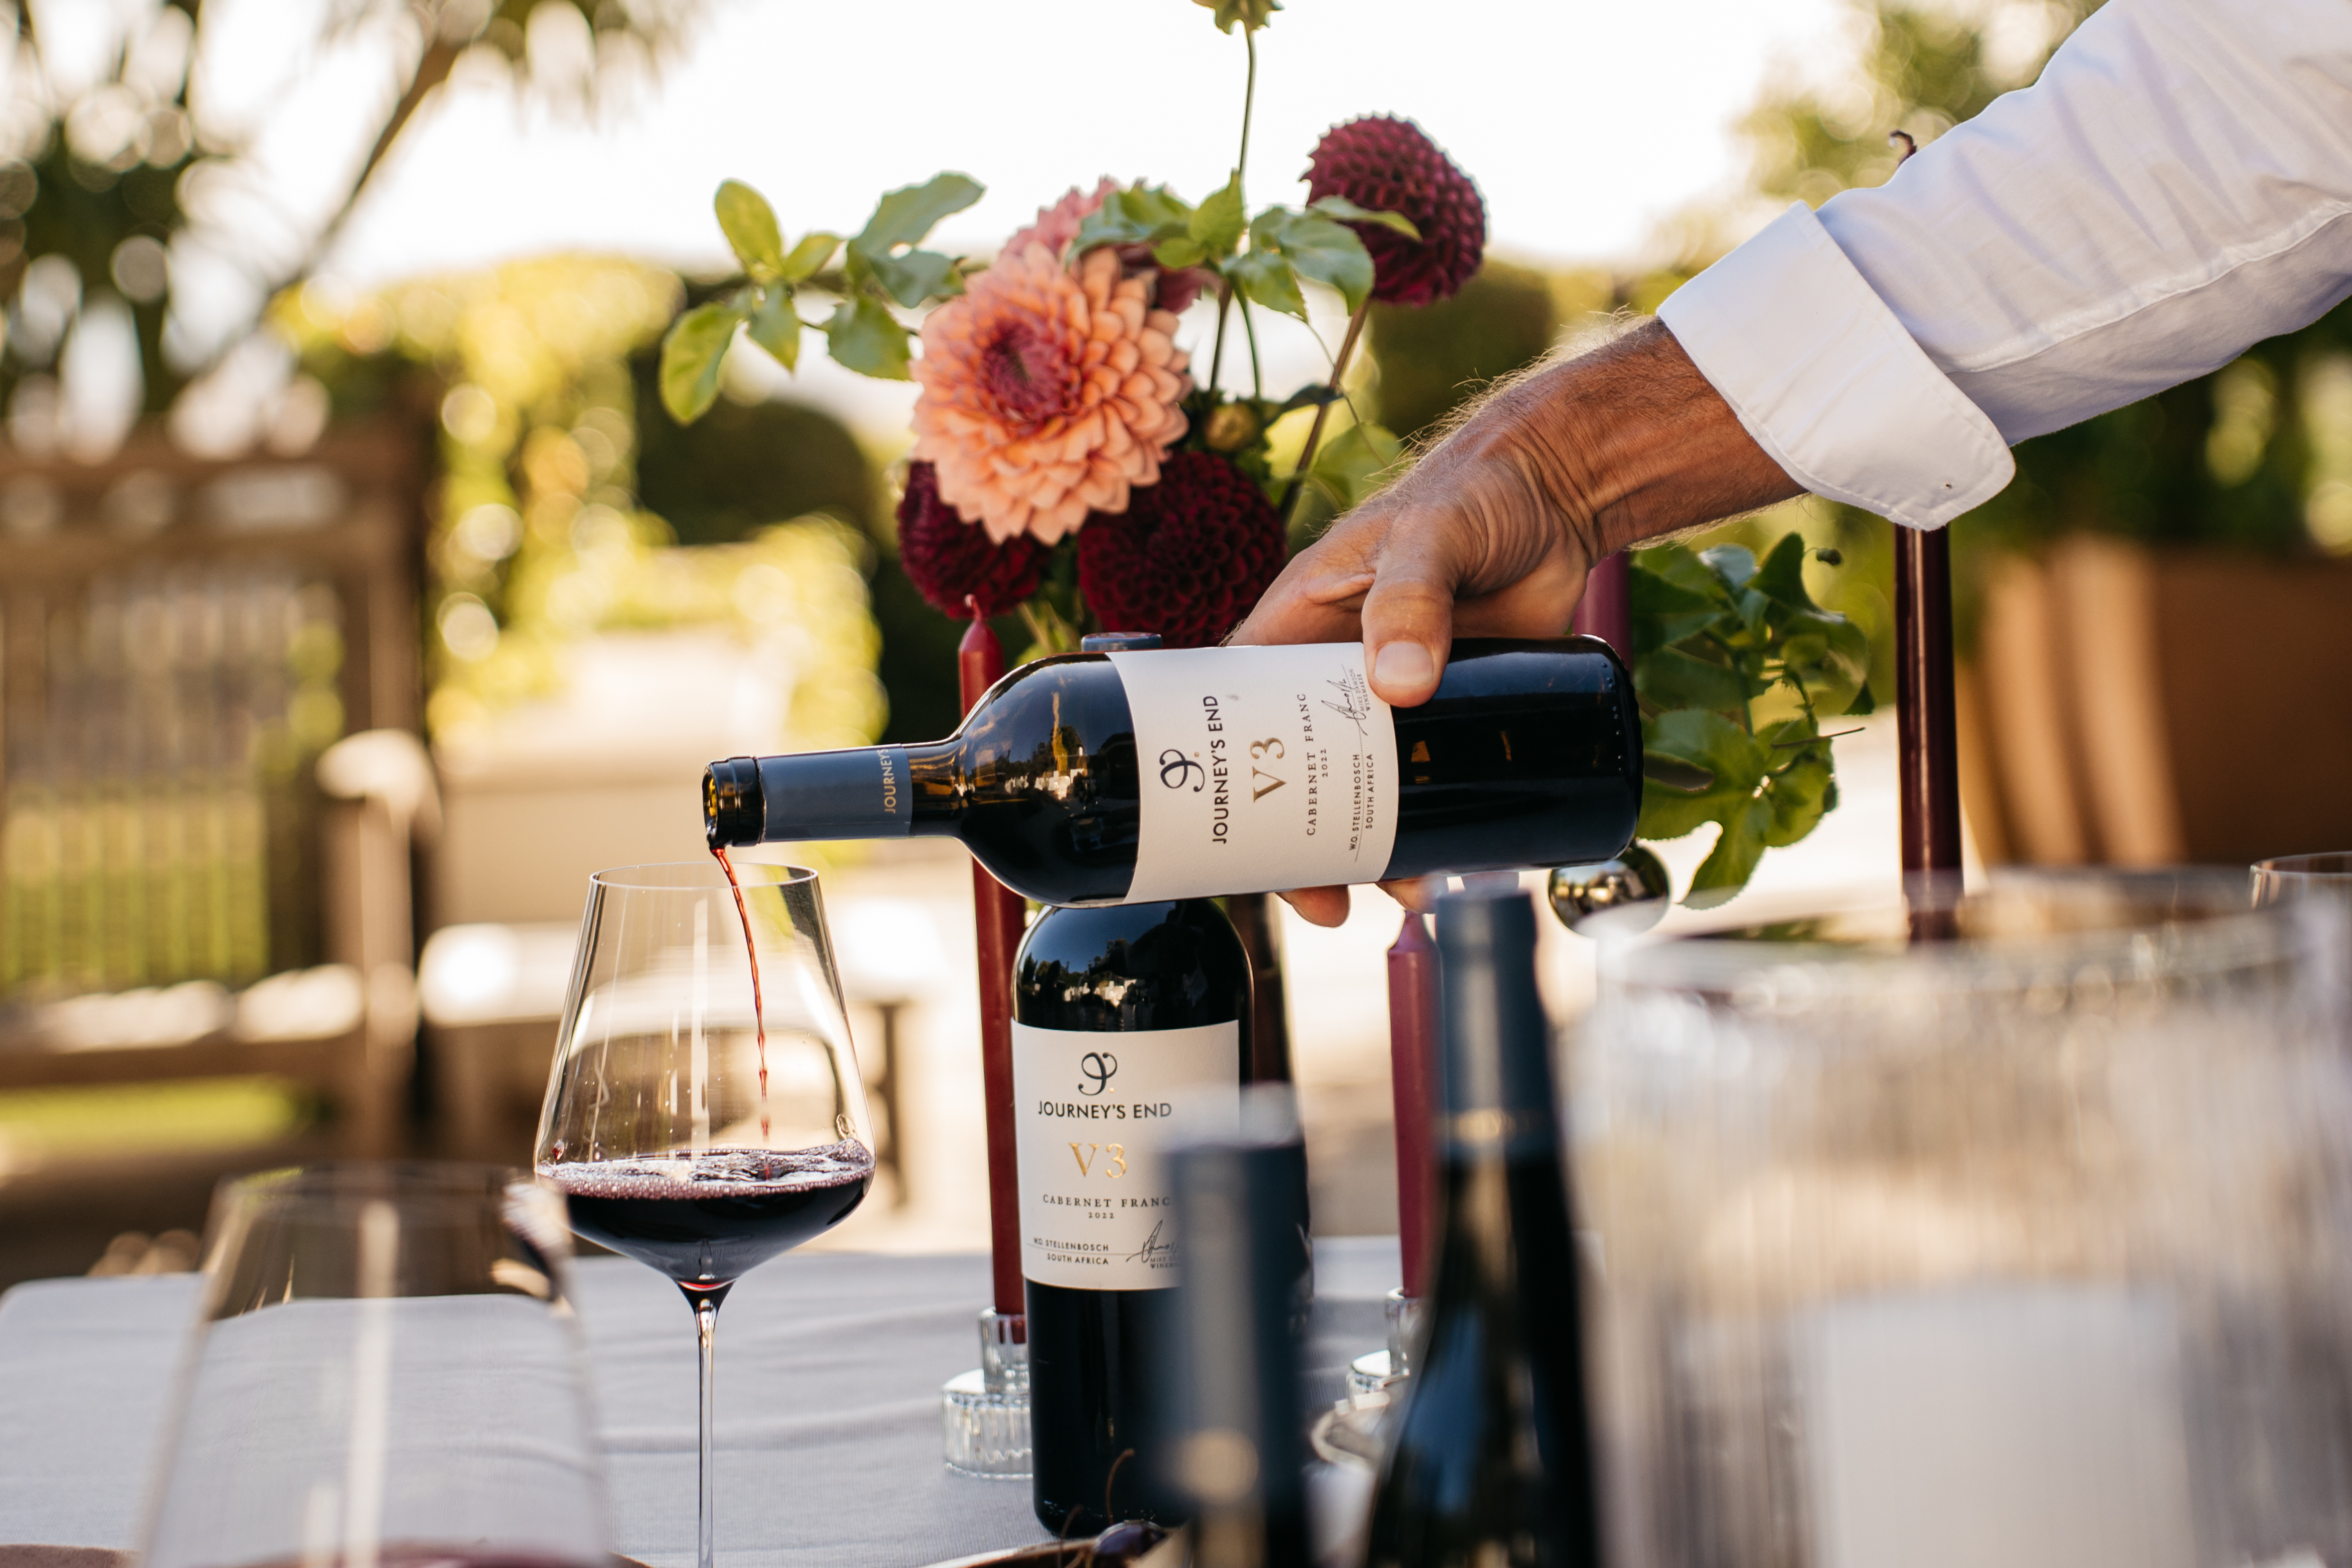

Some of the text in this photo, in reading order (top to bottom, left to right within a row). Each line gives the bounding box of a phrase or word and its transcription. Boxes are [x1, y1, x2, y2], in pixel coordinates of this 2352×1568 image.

[1349, 669, 1361, 693] DAWSON
[1357, 674, 1370, 711] WINEMAKER
[1203, 696, 1228, 844] JOURNEY'S END
[1297, 694, 1317, 836] CABERNET FRANC
[1349, 755, 1361, 850] W.O. STELLENBOSCH
[1366, 754, 1374, 829] SOUTH AFRICA
[1038, 1101, 1172, 1119] JOURNEY'S END
[1043, 1195, 1170, 1207] CABERNET FRANC
[1046, 1239, 1109, 1251] STELLENBOSCH
[1047, 1253, 1109, 1265] SOUTH AFRICA
